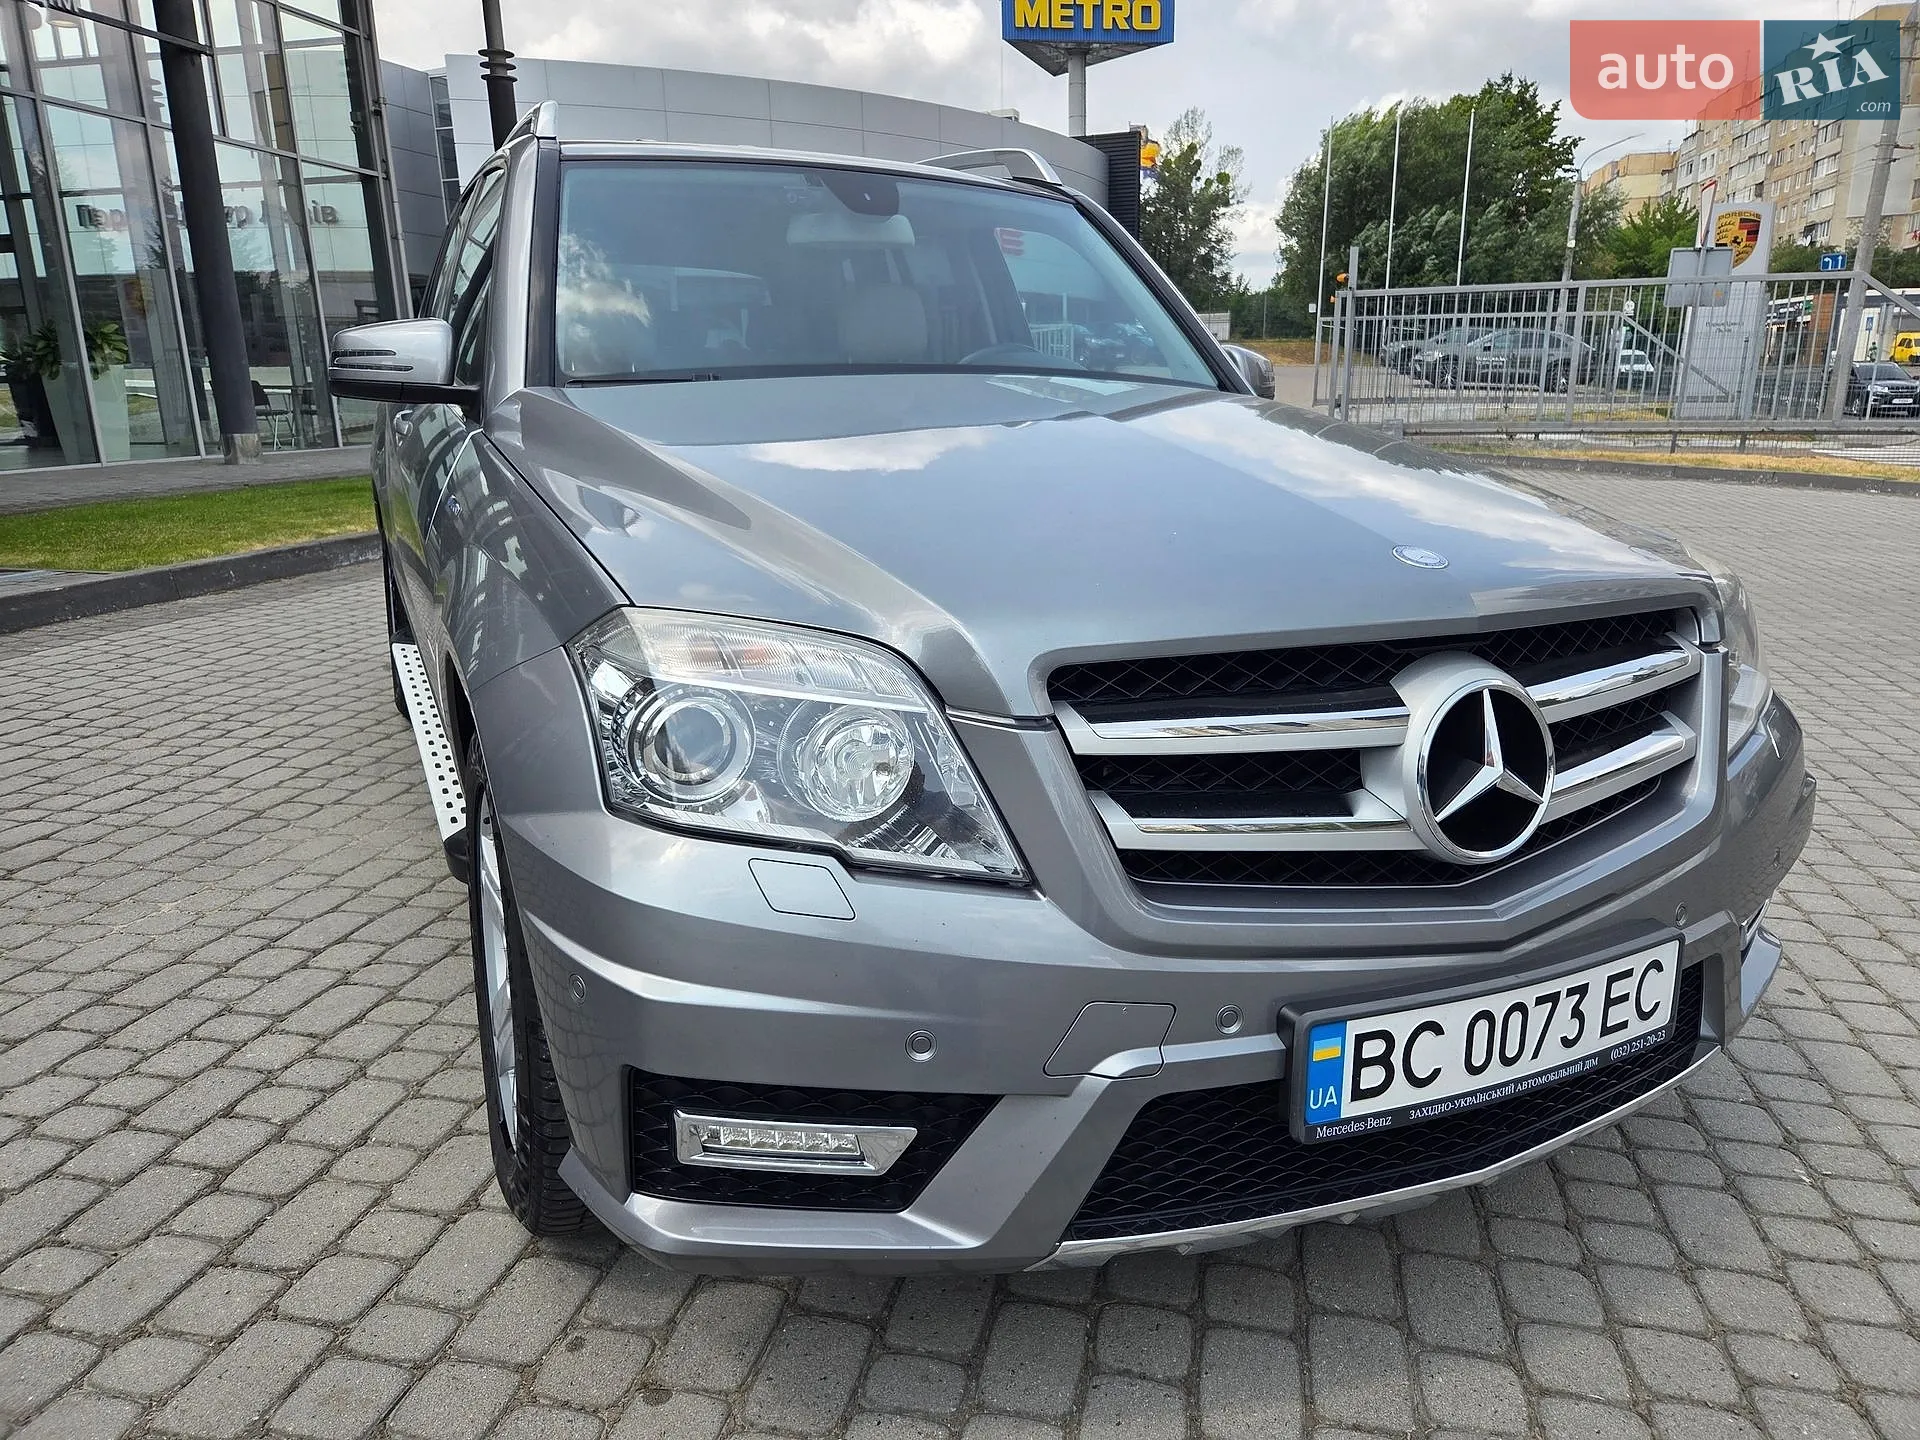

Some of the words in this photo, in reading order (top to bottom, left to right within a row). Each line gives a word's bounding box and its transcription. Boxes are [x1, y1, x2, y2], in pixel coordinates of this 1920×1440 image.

[1014, 0, 1161, 30] METRO
[1350, 1020, 1445, 1103] BC
[1464, 982, 1590, 1076] 0073
[1600, 959, 1664, 1038] EC
[1409, 1083, 1515, 1120] ЗАХІДНО-УКРАЇНСЬКИЙ
[1516, 1063, 1583, 1092] АВТОМОБІЛЬНИЙ
[1583, 1057, 1599, 1072] ДІМ
[1610, 1043, 1630, 1061] (032)
[1631, 1029, 1666, 1053] 251-20-23
[1309, 1085, 1338, 1110] UA
[1316, 1116, 1392, 1139] Mercedes-Benz
